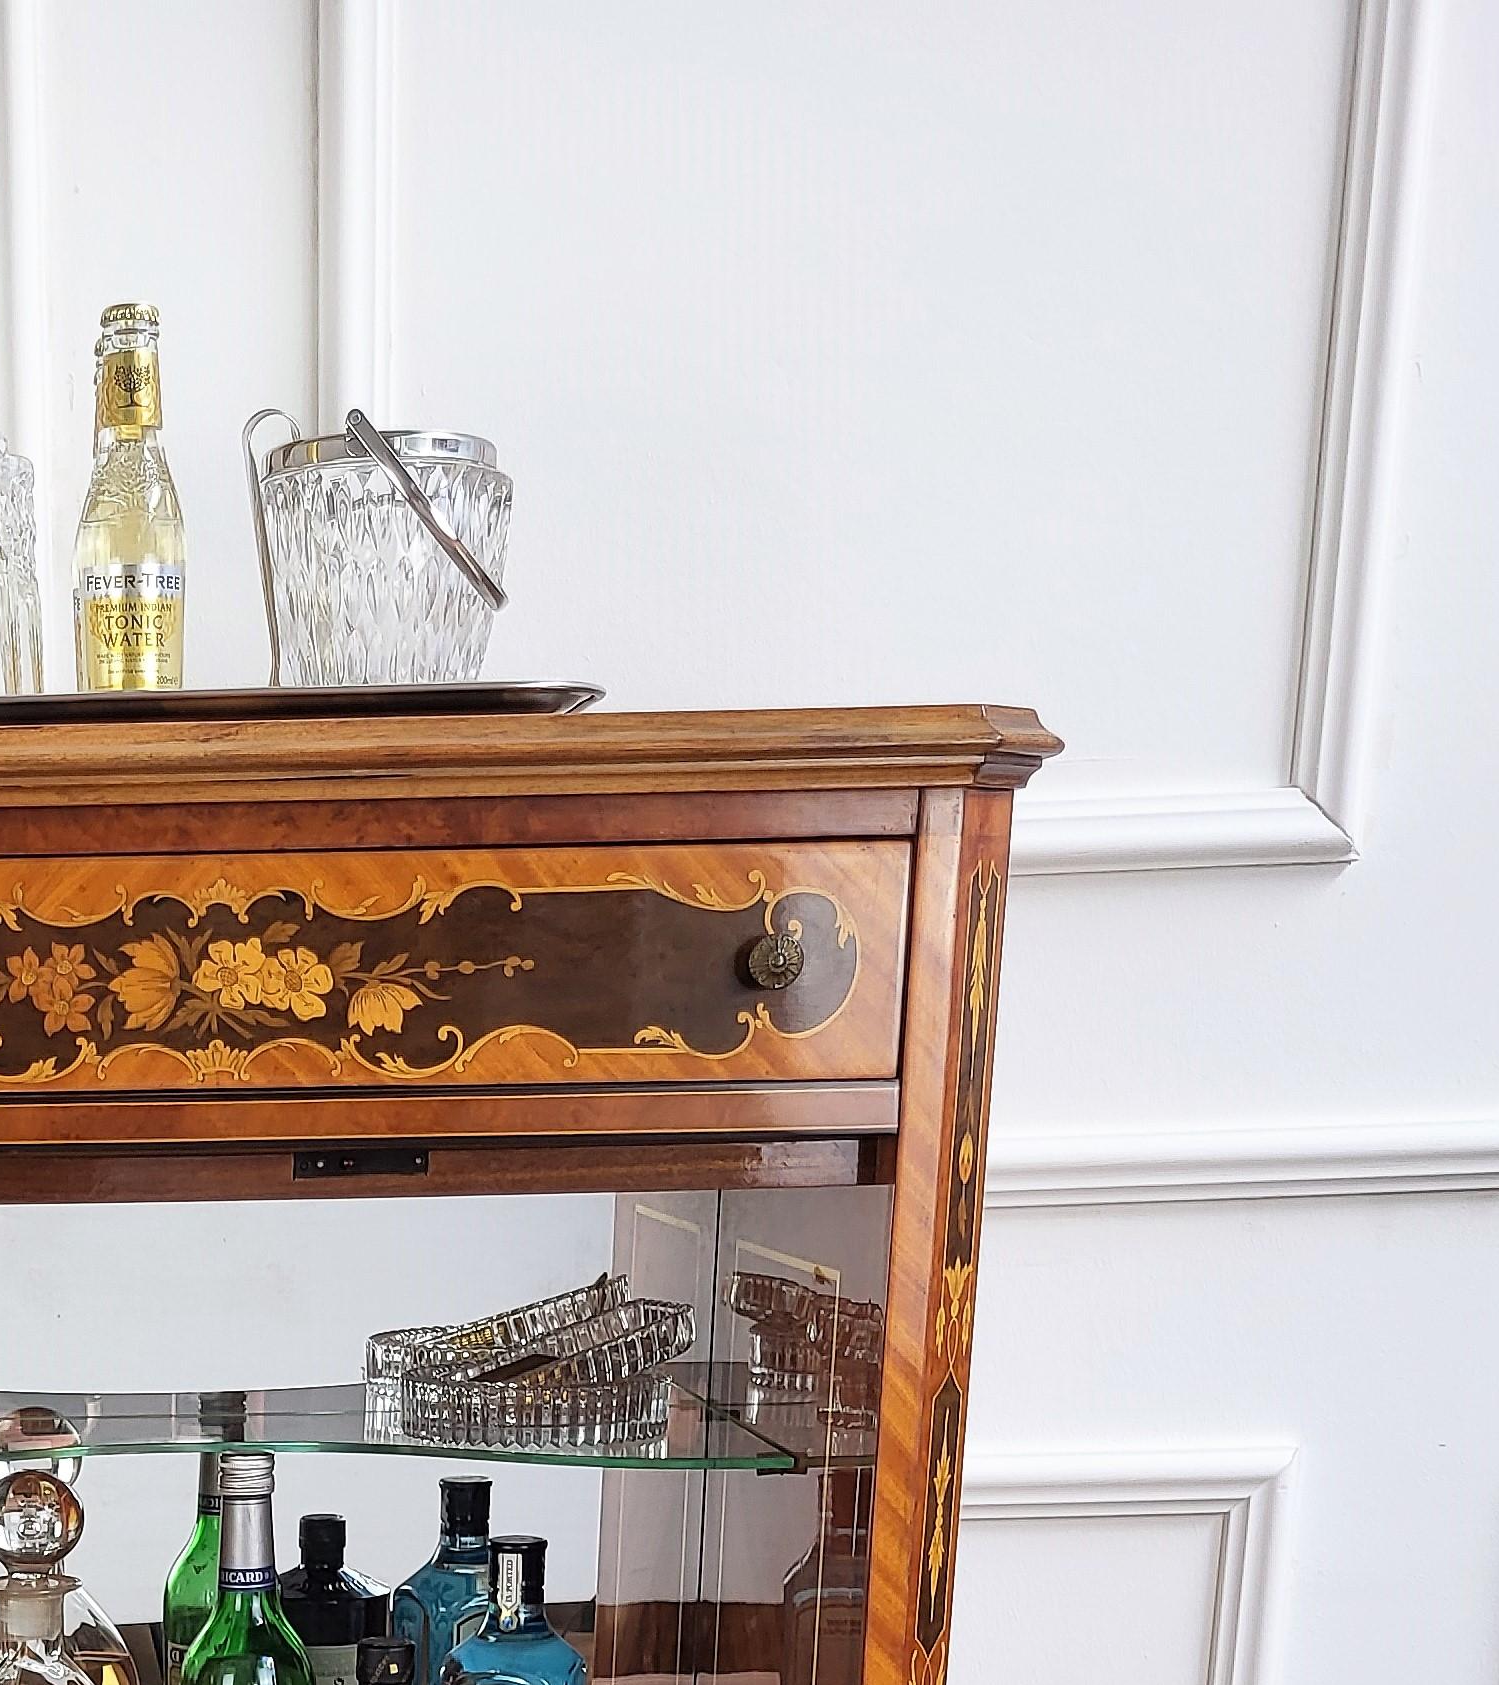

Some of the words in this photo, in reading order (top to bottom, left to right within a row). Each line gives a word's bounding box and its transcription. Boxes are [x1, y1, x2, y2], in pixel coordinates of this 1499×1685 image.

[86, 572, 180, 592] FEVER-TREE
[95, 602, 137, 613] PREMIUM
[140, 602, 172, 612] INDIAN
[104, 615, 163, 631] TONIC
[102, 632, 165, 649] WATER
